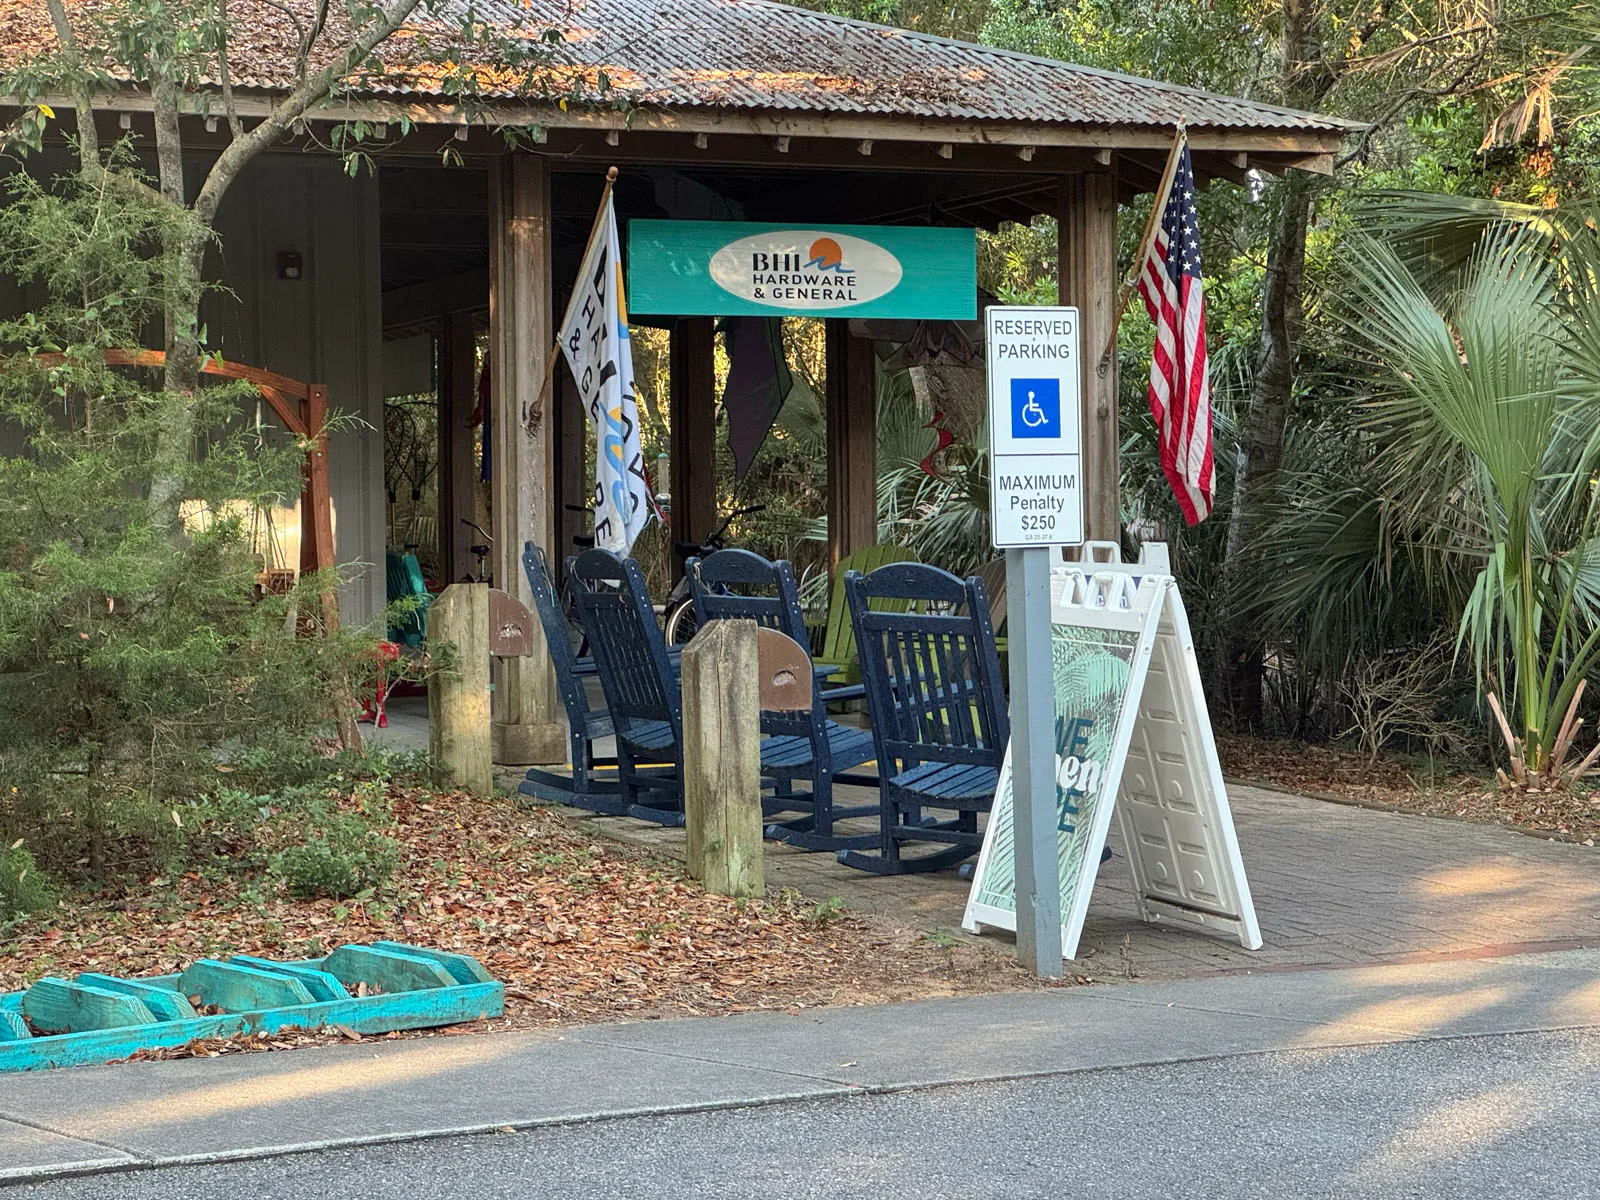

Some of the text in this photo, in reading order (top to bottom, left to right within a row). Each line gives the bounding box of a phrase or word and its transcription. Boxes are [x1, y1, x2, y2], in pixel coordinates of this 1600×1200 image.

[752, 252, 800, 272] BHI
[752, 273, 857, 287] HARDWARE
[753, 287, 857, 301] & GENERAL
[994, 320, 1072, 335] RESERVED
[998, 344, 1070, 359] PARKING
[999, 475, 1075, 491] MAXIMUM
[1010, 495, 1065, 513] Penalty
[1021, 515, 1056, 532] $250
